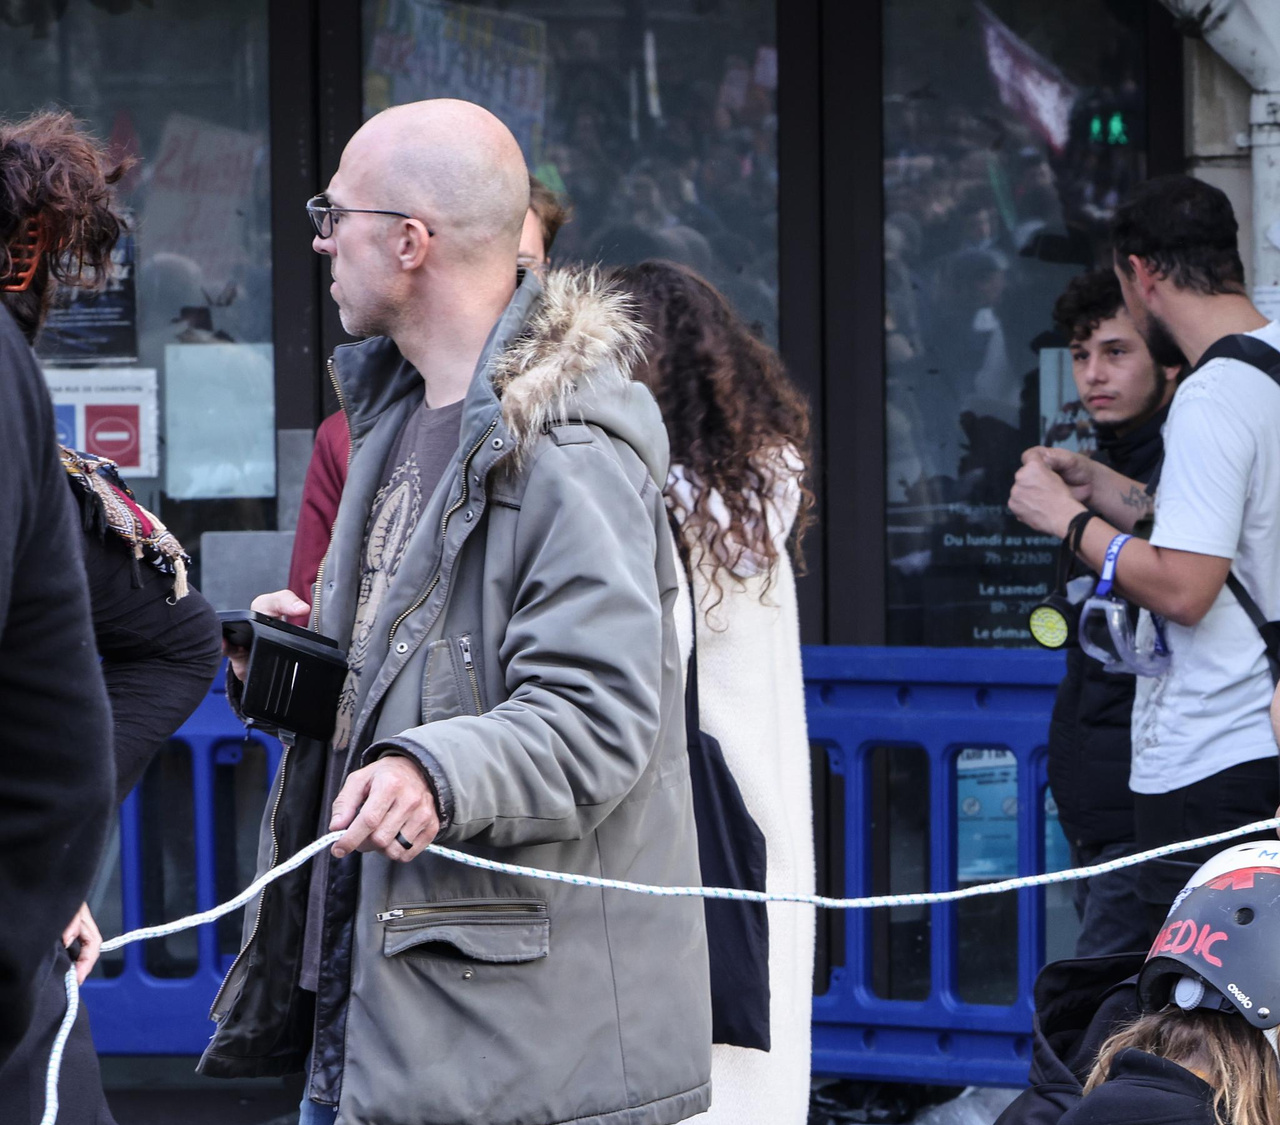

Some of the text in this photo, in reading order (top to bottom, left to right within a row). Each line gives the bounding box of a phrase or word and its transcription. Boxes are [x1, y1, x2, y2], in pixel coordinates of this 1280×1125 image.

[943, 534, 963, 546] Du
[966, 533, 1002, 546] lundi
[1005, 536, 1022, 546] au
[978, 583, 1048, 595] Le samedi
[973, 626, 1031, 639] Le dima
[1146, 919, 1228, 968] MEDIC
[1227, 983, 1253, 1010] oxelo
